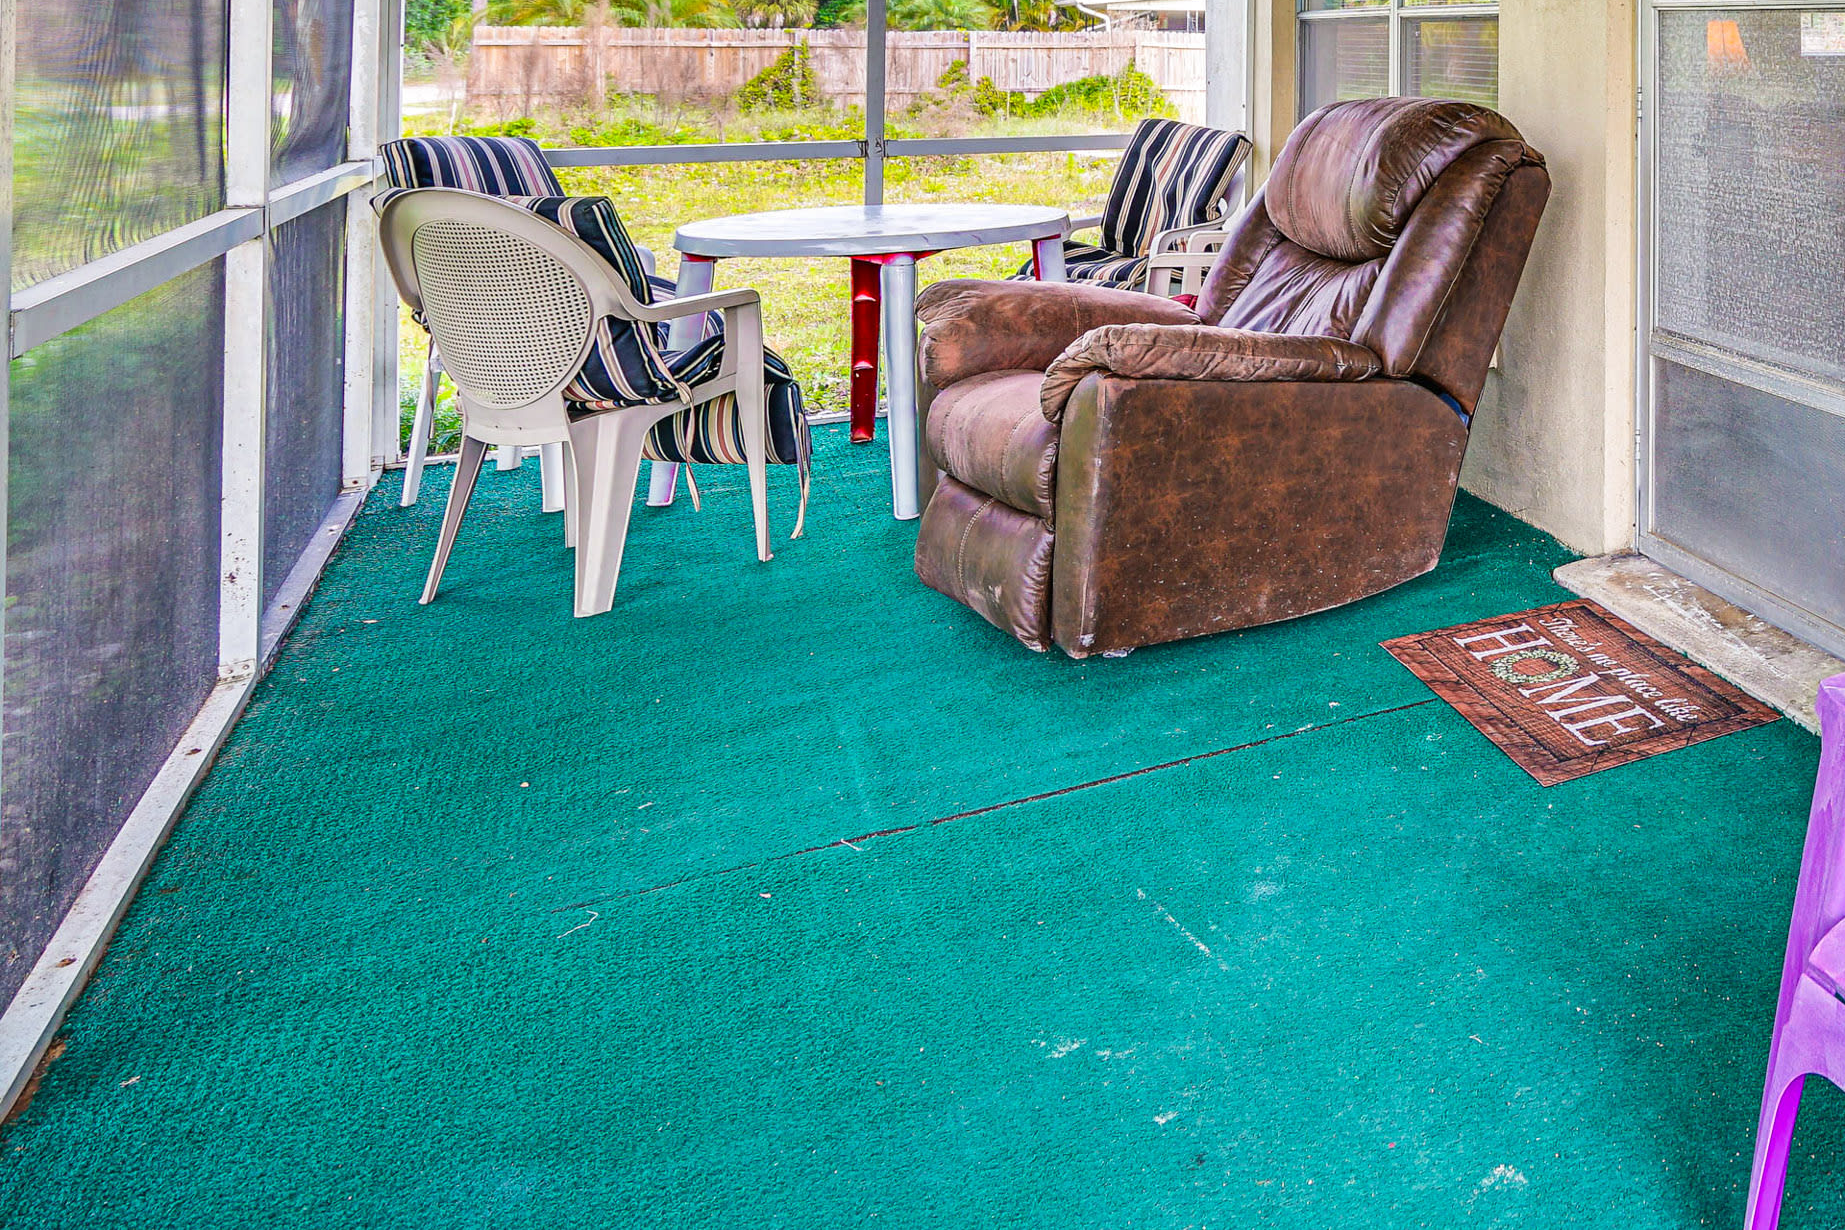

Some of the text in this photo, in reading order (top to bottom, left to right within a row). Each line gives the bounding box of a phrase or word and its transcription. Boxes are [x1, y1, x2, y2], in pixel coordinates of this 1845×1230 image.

[1539, 617, 1701, 722] There's no place like
